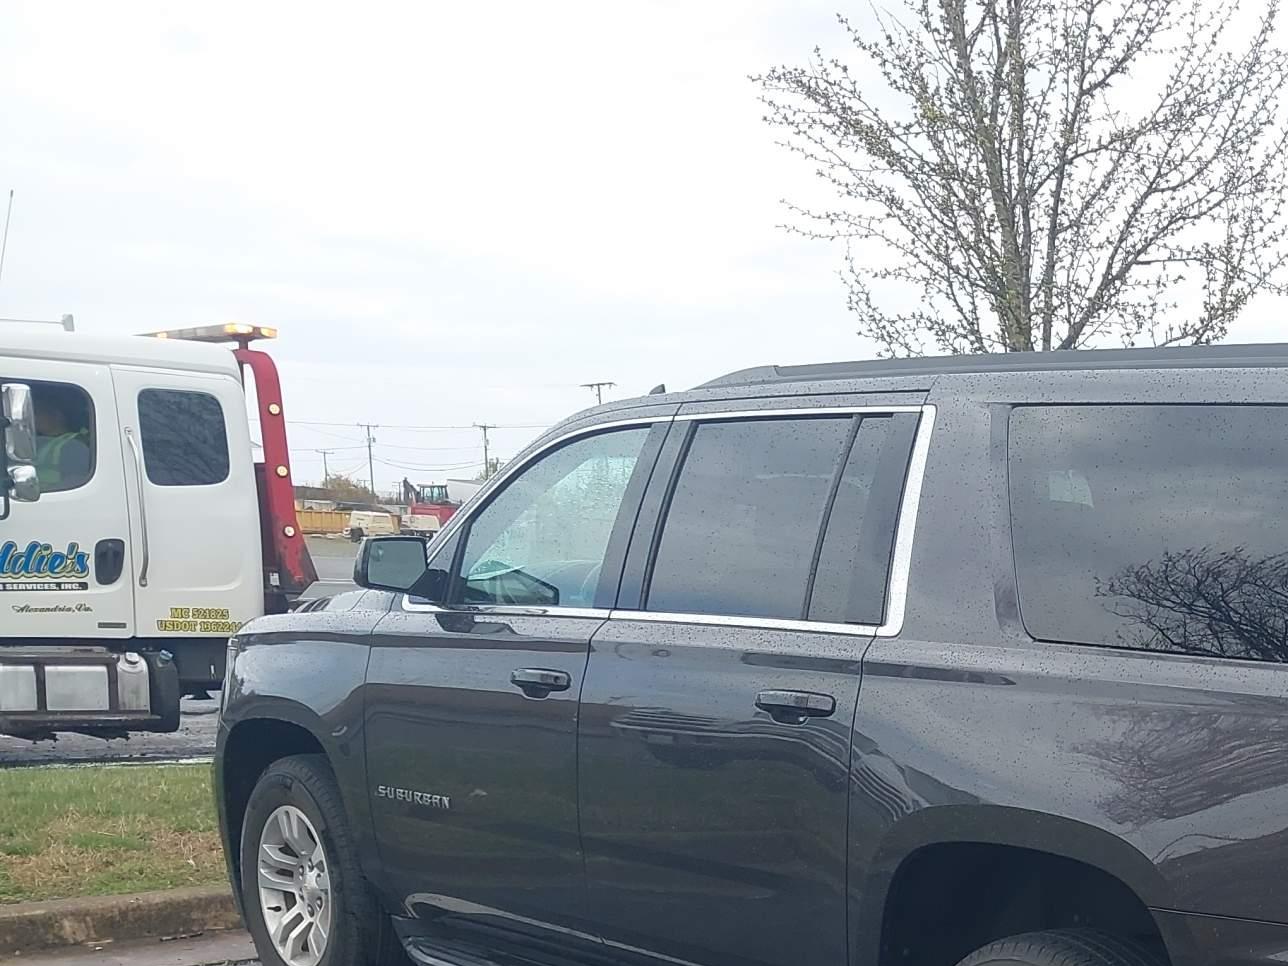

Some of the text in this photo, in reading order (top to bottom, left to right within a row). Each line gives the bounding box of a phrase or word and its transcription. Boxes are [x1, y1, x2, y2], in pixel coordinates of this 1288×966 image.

[61, 583, 82, 591] INC.
[170, 607, 230, 620] MC 521825
[157, 619, 198, 632] USDOT
[377, 784, 451, 809] SUBURBAN
